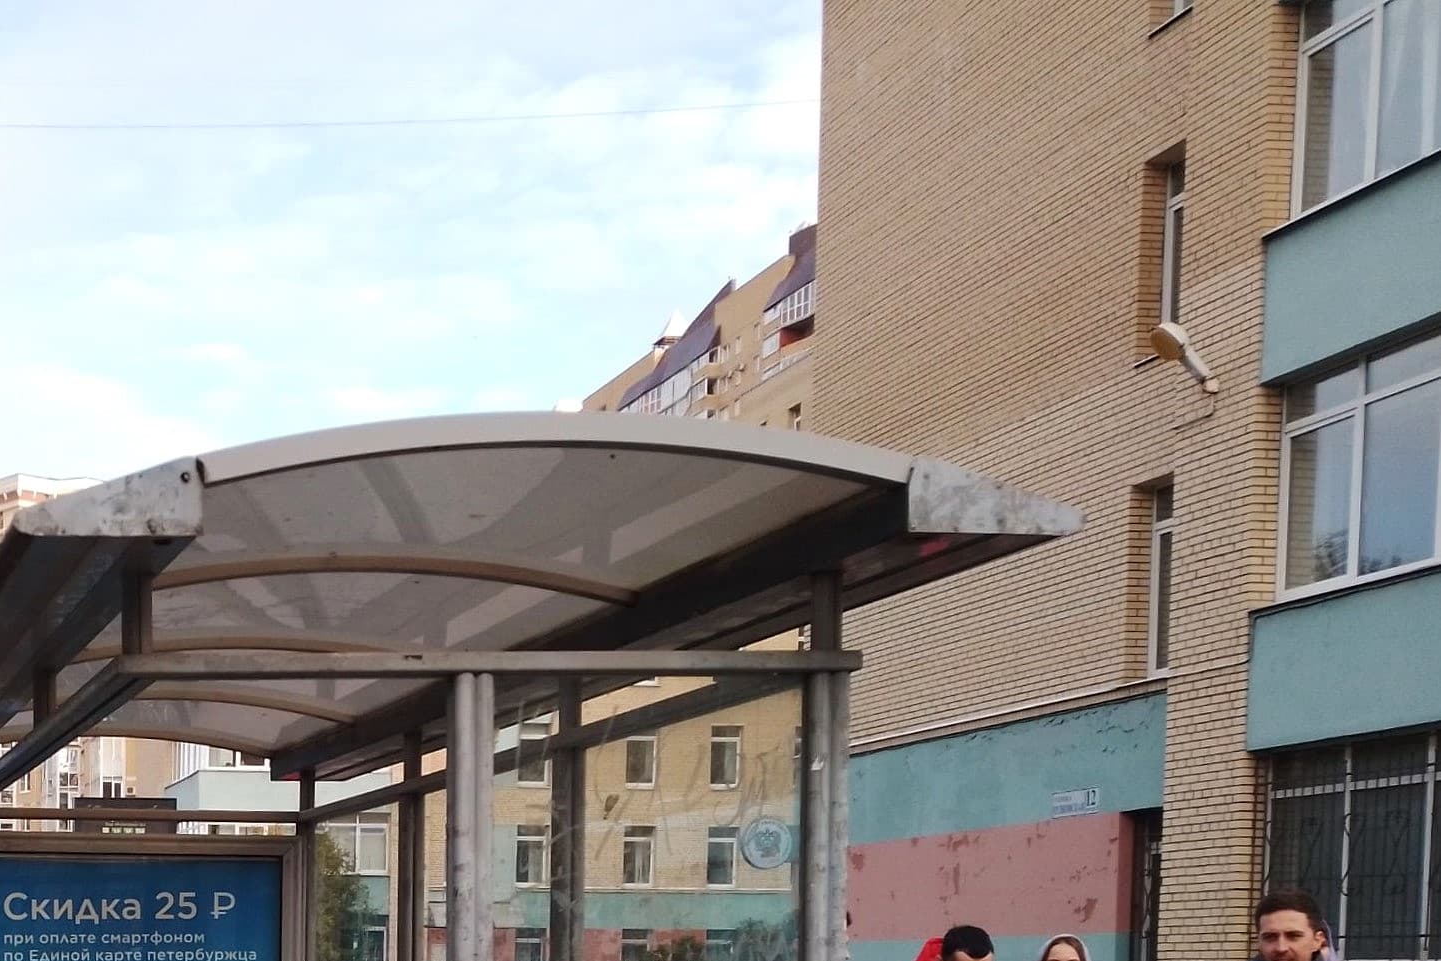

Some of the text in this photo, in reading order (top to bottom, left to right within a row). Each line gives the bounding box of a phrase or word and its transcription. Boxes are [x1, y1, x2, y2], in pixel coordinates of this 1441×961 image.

[1086, 789, 1096, 807] 12
[3, 891, 142, 924] Скидка
[154, 891, 197, 921] 25
[3, 930, 205, 948] при оплате смартфоном
[3, 951, 24, 961] по
